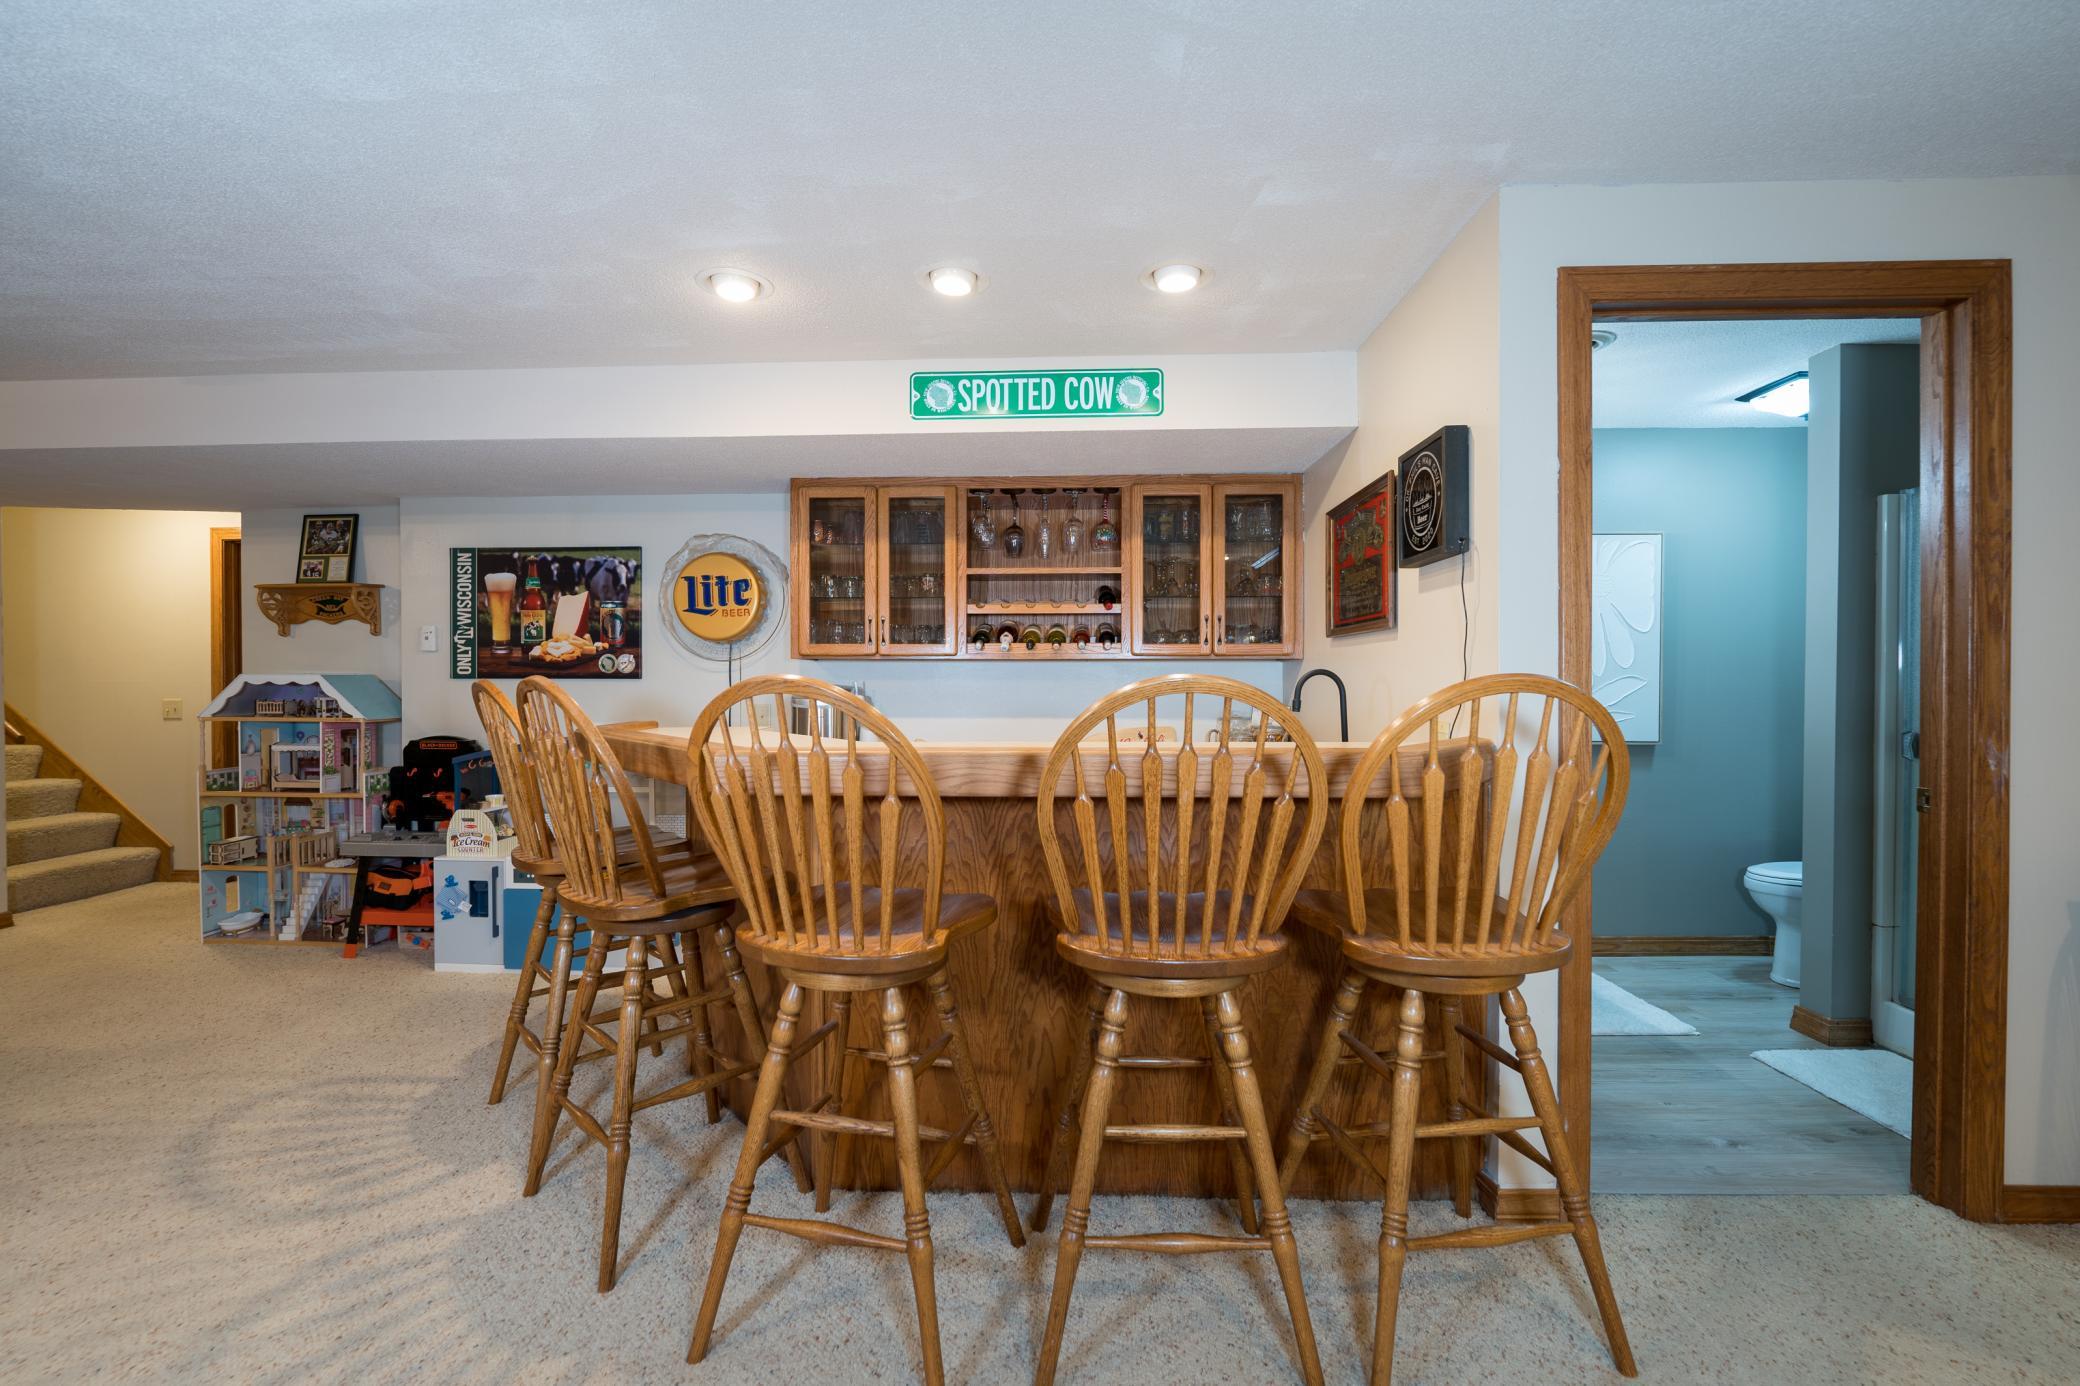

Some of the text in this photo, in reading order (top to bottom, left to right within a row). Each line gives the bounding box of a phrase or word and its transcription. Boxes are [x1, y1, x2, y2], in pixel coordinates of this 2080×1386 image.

[957, 377, 1055, 412] SPOTTED
[1064, 376, 1114, 411] COW
[456, 552, 472, 625] WISCONSIN
[680, 574, 753, 616] Lite
[721, 608, 751, 617] BEER
[456, 643, 472, 675] ONLY
[464, 836, 491, 848] Cream
